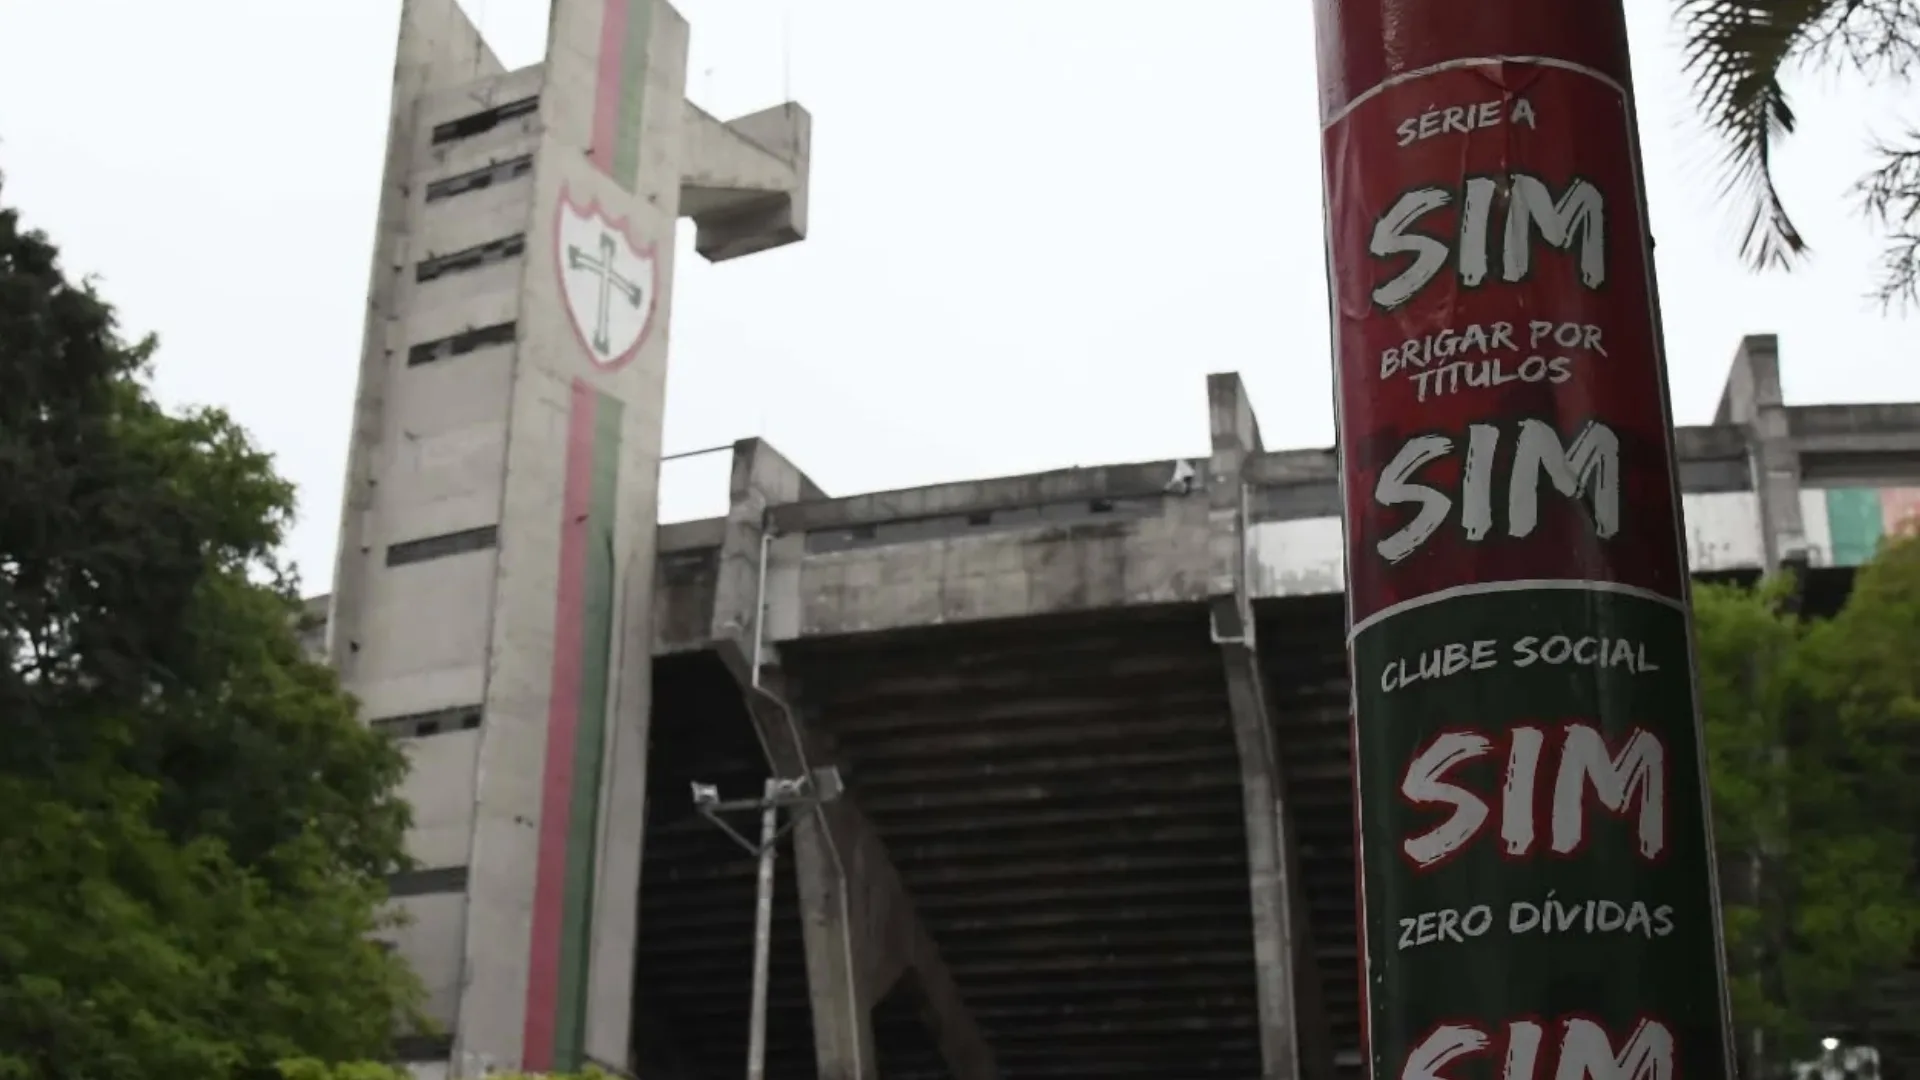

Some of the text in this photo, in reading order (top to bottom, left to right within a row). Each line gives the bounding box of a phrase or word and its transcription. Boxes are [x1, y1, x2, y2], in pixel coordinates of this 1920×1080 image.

[1397, 99, 1535, 145] SÉRIE A
[1370, 174, 1603, 308] SIM
[1380, 320, 1607, 379] BRIGAR POR
[1410, 357, 1571, 402] TÍTULOS
[1375, 419, 1619, 564] SIM
[1381, 636, 1659, 693] CLUBE SOCIAL
[1402, 724, 1663, 867] SIM
[1398, 890, 1674, 950] ZERO DÍVIDAS
